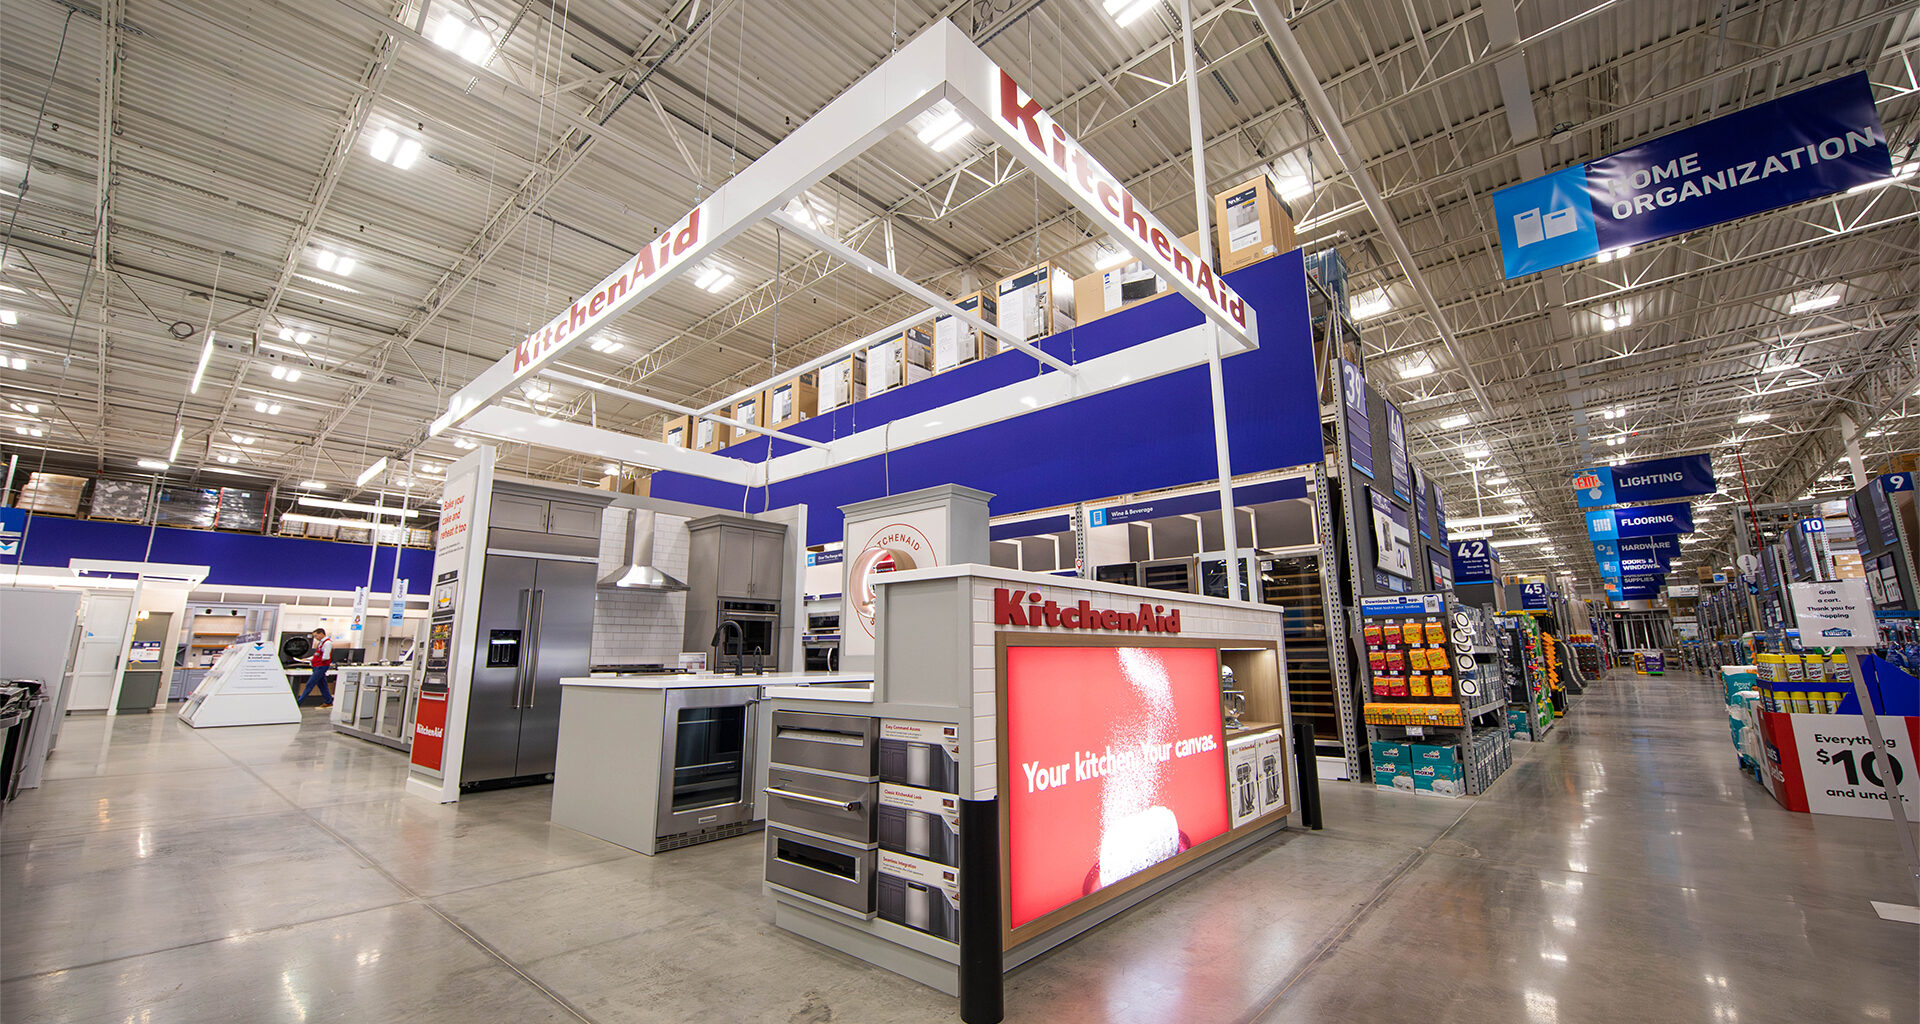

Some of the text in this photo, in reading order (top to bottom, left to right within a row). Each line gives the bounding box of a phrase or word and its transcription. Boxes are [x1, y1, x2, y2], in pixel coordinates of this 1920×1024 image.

[1607, 151, 1702, 198] HOME
[1611, 125, 1878, 221] ORGANIZATION
[1000, 68, 1247, 330] KitchenAid
[513, 207, 701, 375] KitchenAid
[1344, 364, 1361, 409] 39
[1577, 475, 1597, 489] EXIT
[1619, 471, 1683, 488] LIGHTING
[1889, 475, 1905, 490] 9
[454, 495, 465, 510] your
[1111, 510, 1125, 518] Wine
[1129, 506, 1154, 516] Beverage
[1621, 514, 1675, 527] FLOORING
[1803, 519, 1822, 531] 10
[877, 533, 920, 551] TCHENAID
[1621, 541, 1671, 552] HARDWARE
[1457, 541, 1485, 559] 42
[1621, 558, 1647, 566] DOORS
[1525, 583, 1543, 595] 45
[994, 587, 1181, 633] KitchenAid
[416, 722, 443, 738] KitchenAid
[1022, 760, 1070, 793] Your
[1140, 741, 1173, 764] Your
[1174, 734, 1217, 759] canvas.
[1376, 765, 1396, 773] moxie
[1816, 748, 1904, 788] $10
[1414, 768, 1435, 777] moxie
[1826, 788, 1856, 798] and
